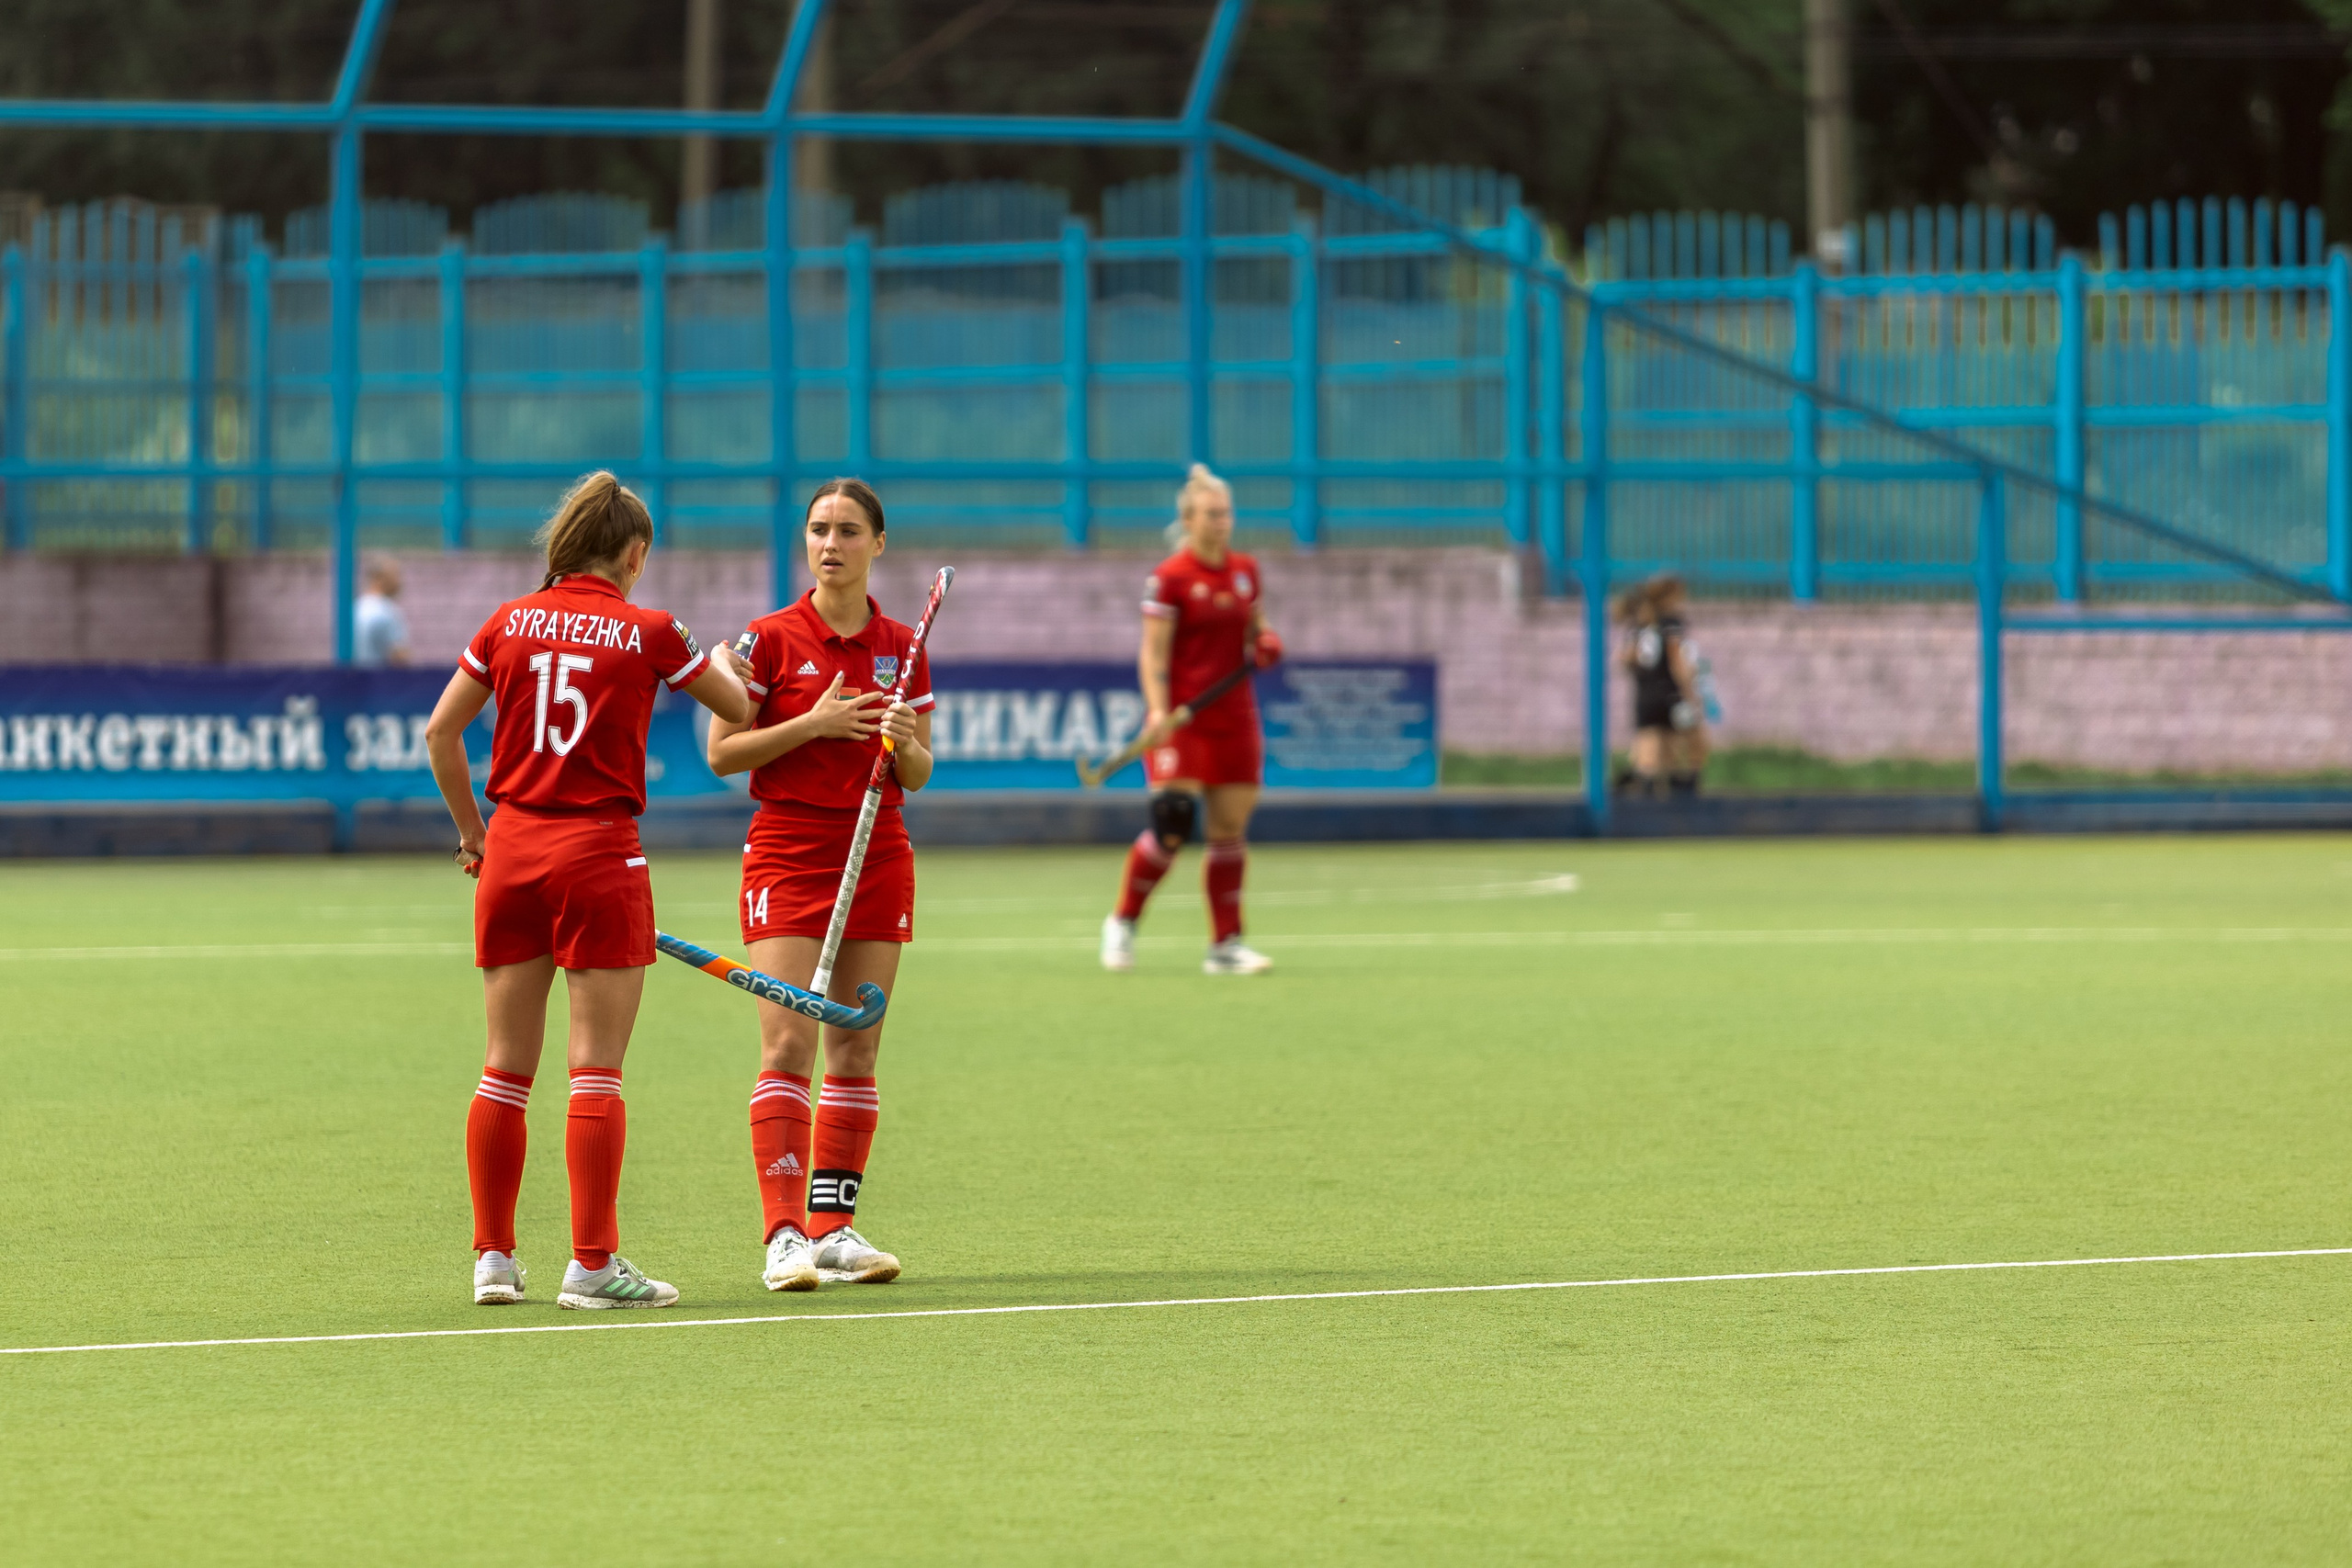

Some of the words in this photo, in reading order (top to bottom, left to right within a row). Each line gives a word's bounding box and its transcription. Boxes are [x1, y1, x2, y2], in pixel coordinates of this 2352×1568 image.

[505, 608, 641, 654] SYRAYEZHKA
[528, 651, 594, 757] 15
[745, 887, 769, 928] 14
[765, 1165, 804, 1177] adidas
[838, 1179, 858, 1206] C
